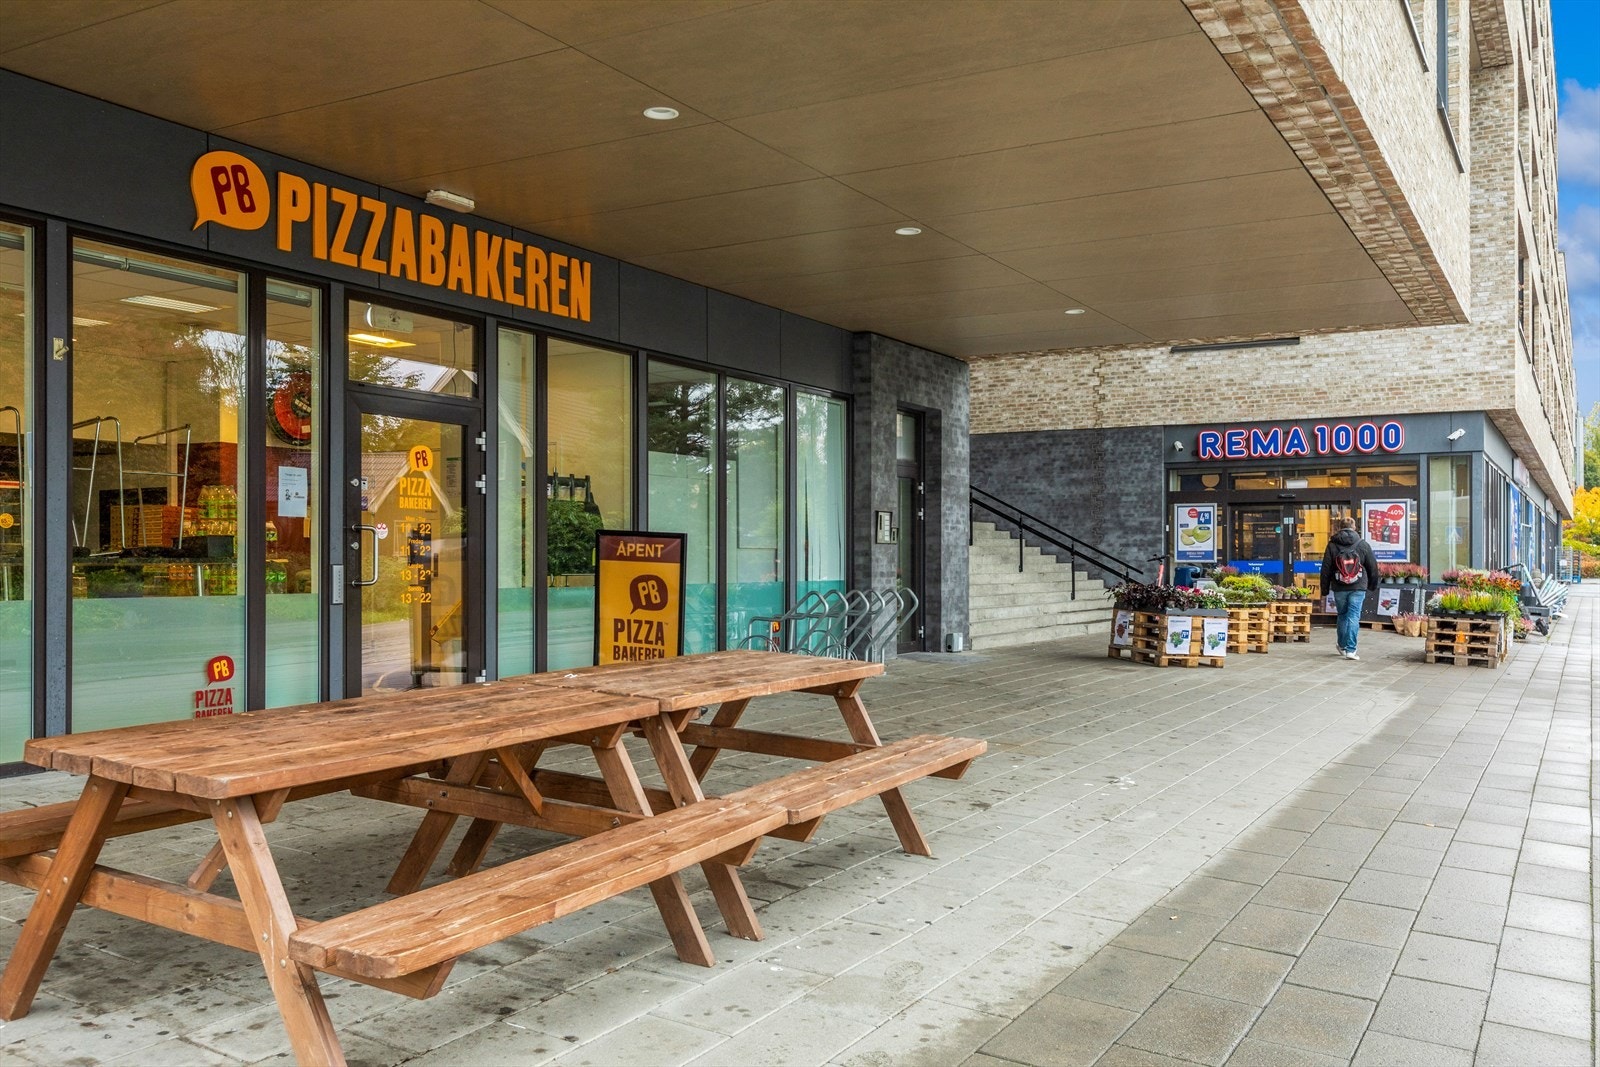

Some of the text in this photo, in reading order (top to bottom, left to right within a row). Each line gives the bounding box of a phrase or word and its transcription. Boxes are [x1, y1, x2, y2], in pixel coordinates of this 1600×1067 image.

[210, 164, 256, 215] PB
[277, 171, 591, 322] PIZZABAKEREN
[1198, 421, 1405, 460] REMA 1000
[415, 450, 428, 468] PB
[400, 477, 431, 496] PIZZA
[400, 497, 432, 509] BAKEREN
[420, 524, 431, 534] 22
[616, 541, 664, 558] ÅPENT
[400, 570, 412, 580] 13
[400, 593, 412, 604] 13
[420, 592, 432, 603] 22
[638, 580, 661, 606] PB
[613, 618, 665, 646] PIZZA
[613, 645, 665, 660] BAKEREN
[213, 660, 230, 680] PB
[195, 688, 232, 708] PIZZA
